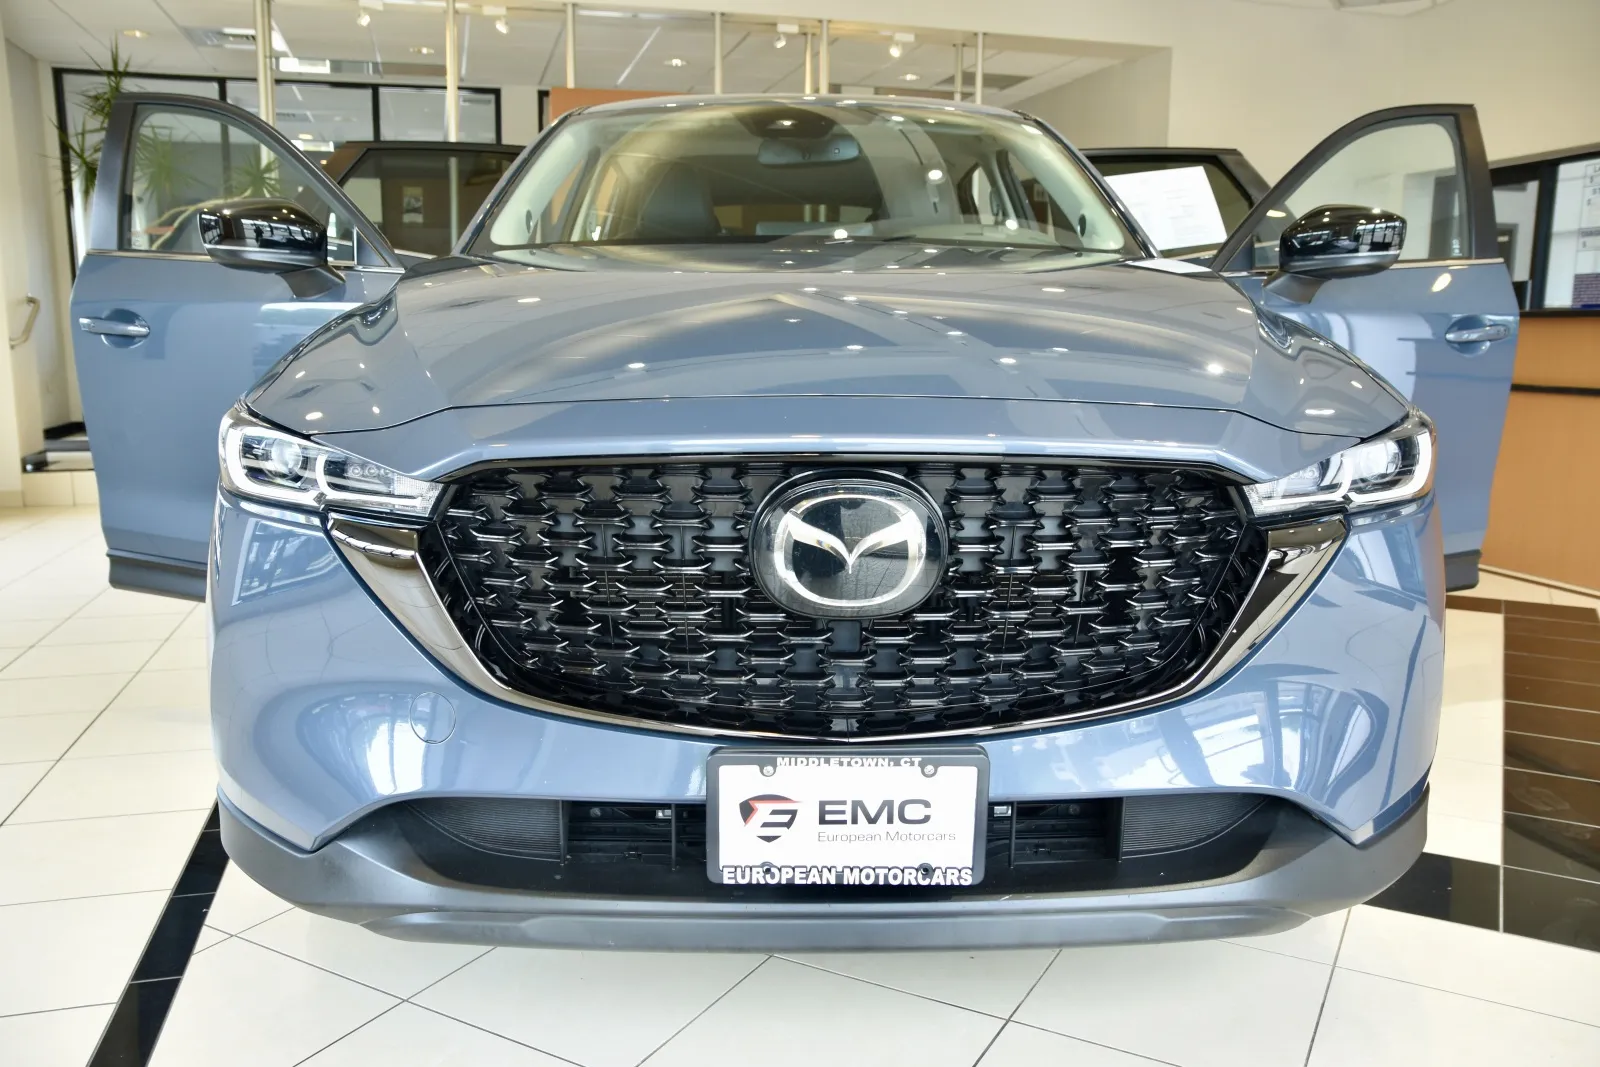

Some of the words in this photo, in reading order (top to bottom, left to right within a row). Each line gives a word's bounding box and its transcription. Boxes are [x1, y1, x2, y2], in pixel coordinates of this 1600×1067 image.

[776, 757, 894, 767] MIDDLETOWN,
[900, 757, 922, 767] CT
[818, 799, 932, 825] EMC
[817, 831, 882, 843] European
[886, 831, 956, 842] Motorcars
[722, 865, 837, 885] EUROPEAN
[843, 866, 973, 886] MOTORCARS
